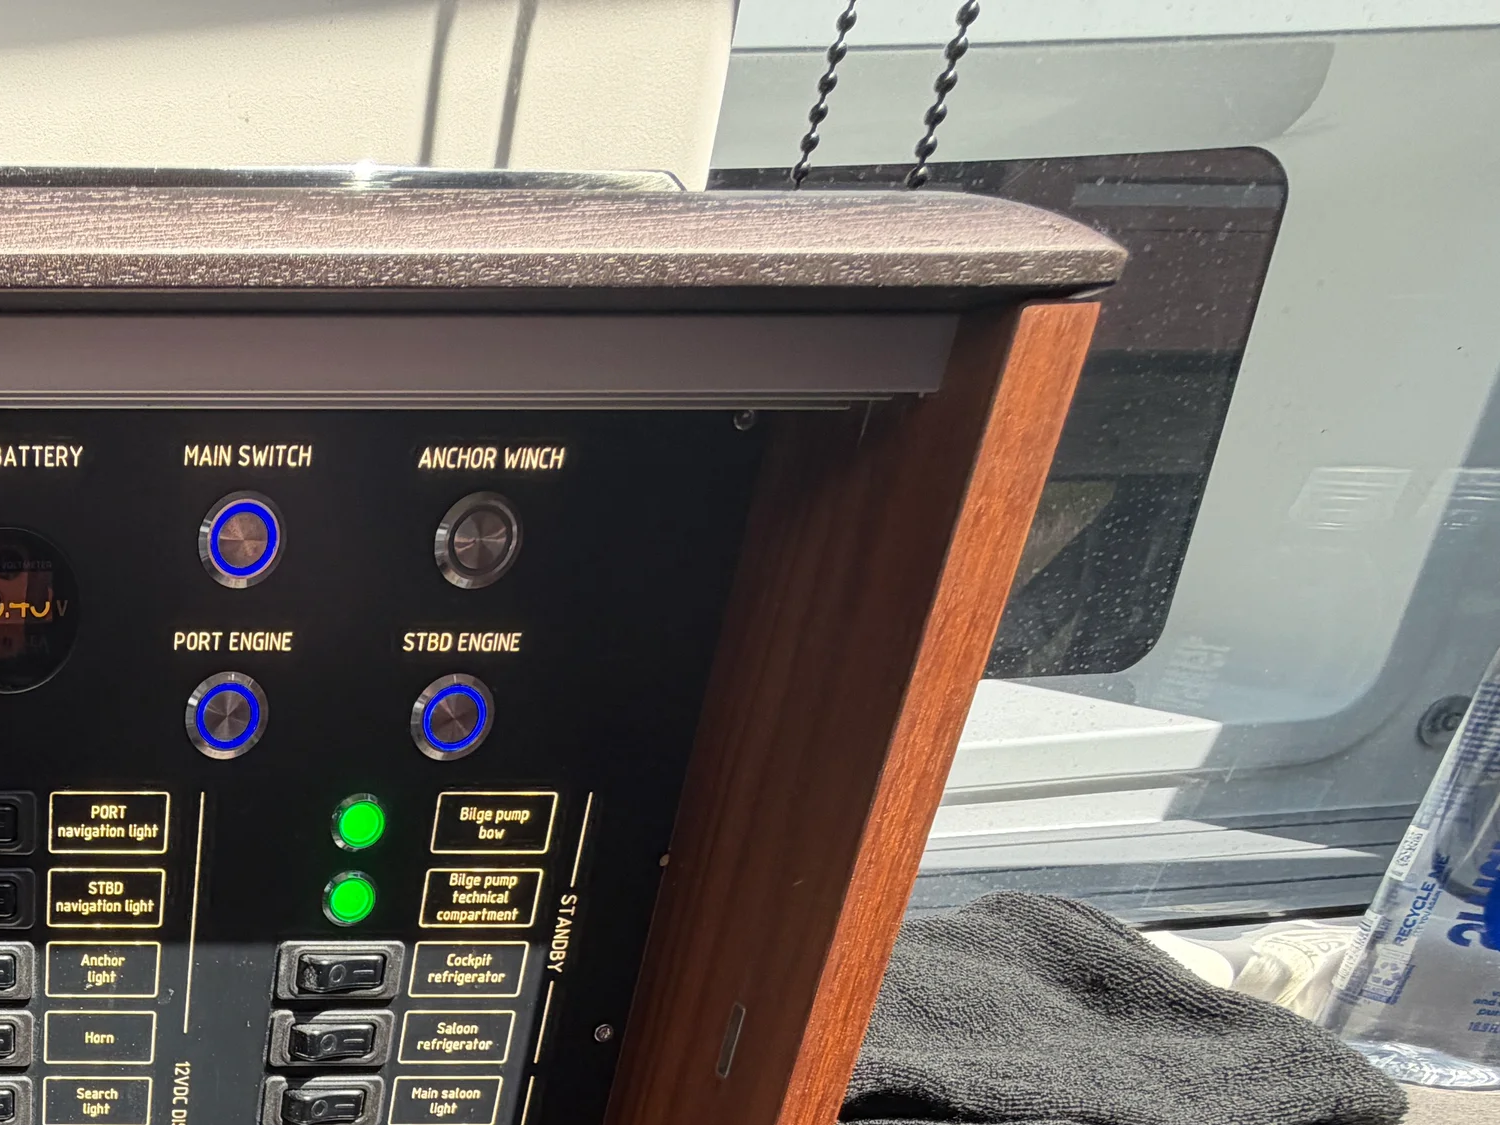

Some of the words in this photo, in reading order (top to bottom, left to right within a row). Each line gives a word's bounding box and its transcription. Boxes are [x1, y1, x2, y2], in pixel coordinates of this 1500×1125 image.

[183, 444, 232, 467] MAIN
[238, 444, 312, 467] SWITCH
[418, 446, 497, 469] ANCHOR
[504, 446, 565, 469] WINCH
[174, 632, 223, 651] PORT
[229, 632, 293, 651] ENGINE
[403, 632, 452, 651] STBD
[457, 632, 522, 651] ENGINE
[90, 805, 126, 819] PORT
[459, 807, 493, 822] Bilge
[495, 808, 530, 823] pump
[57, 824, 125, 840] navigation
[128, 824, 159, 840] light
[478, 826, 505, 840] bow
[88, 881, 124, 895] STBD
[449, 873, 481, 888] Bilge
[483, 875, 518, 889] pump
[452, 890, 509, 904] technical
[55, 899, 122, 915] navigation
[125, 899, 154, 914] light
[436, 907, 519, 922] compartment
[1394, 881, 1436, 947] RECYCLE
[547, 894, 578, 973] STANDBY
[80, 954, 125, 968] Anchor
[446, 953, 493, 968] Cockpit
[87, 970, 116, 986] light
[428, 970, 506, 985] refrigerator
[436, 1022, 479, 1035] Saloon
[85, 1031, 114, 1044] Horn
[417, 1038, 493, 1052] refrigerator
[172, 1061, 191, 1105] 12VDC
[76, 1088, 118, 1100] Search
[412, 1087, 439, 1099] Main
[441, 1087, 480, 1100] saloon
[82, 1102, 110, 1116] light
[429, 1102, 457, 1116] light
